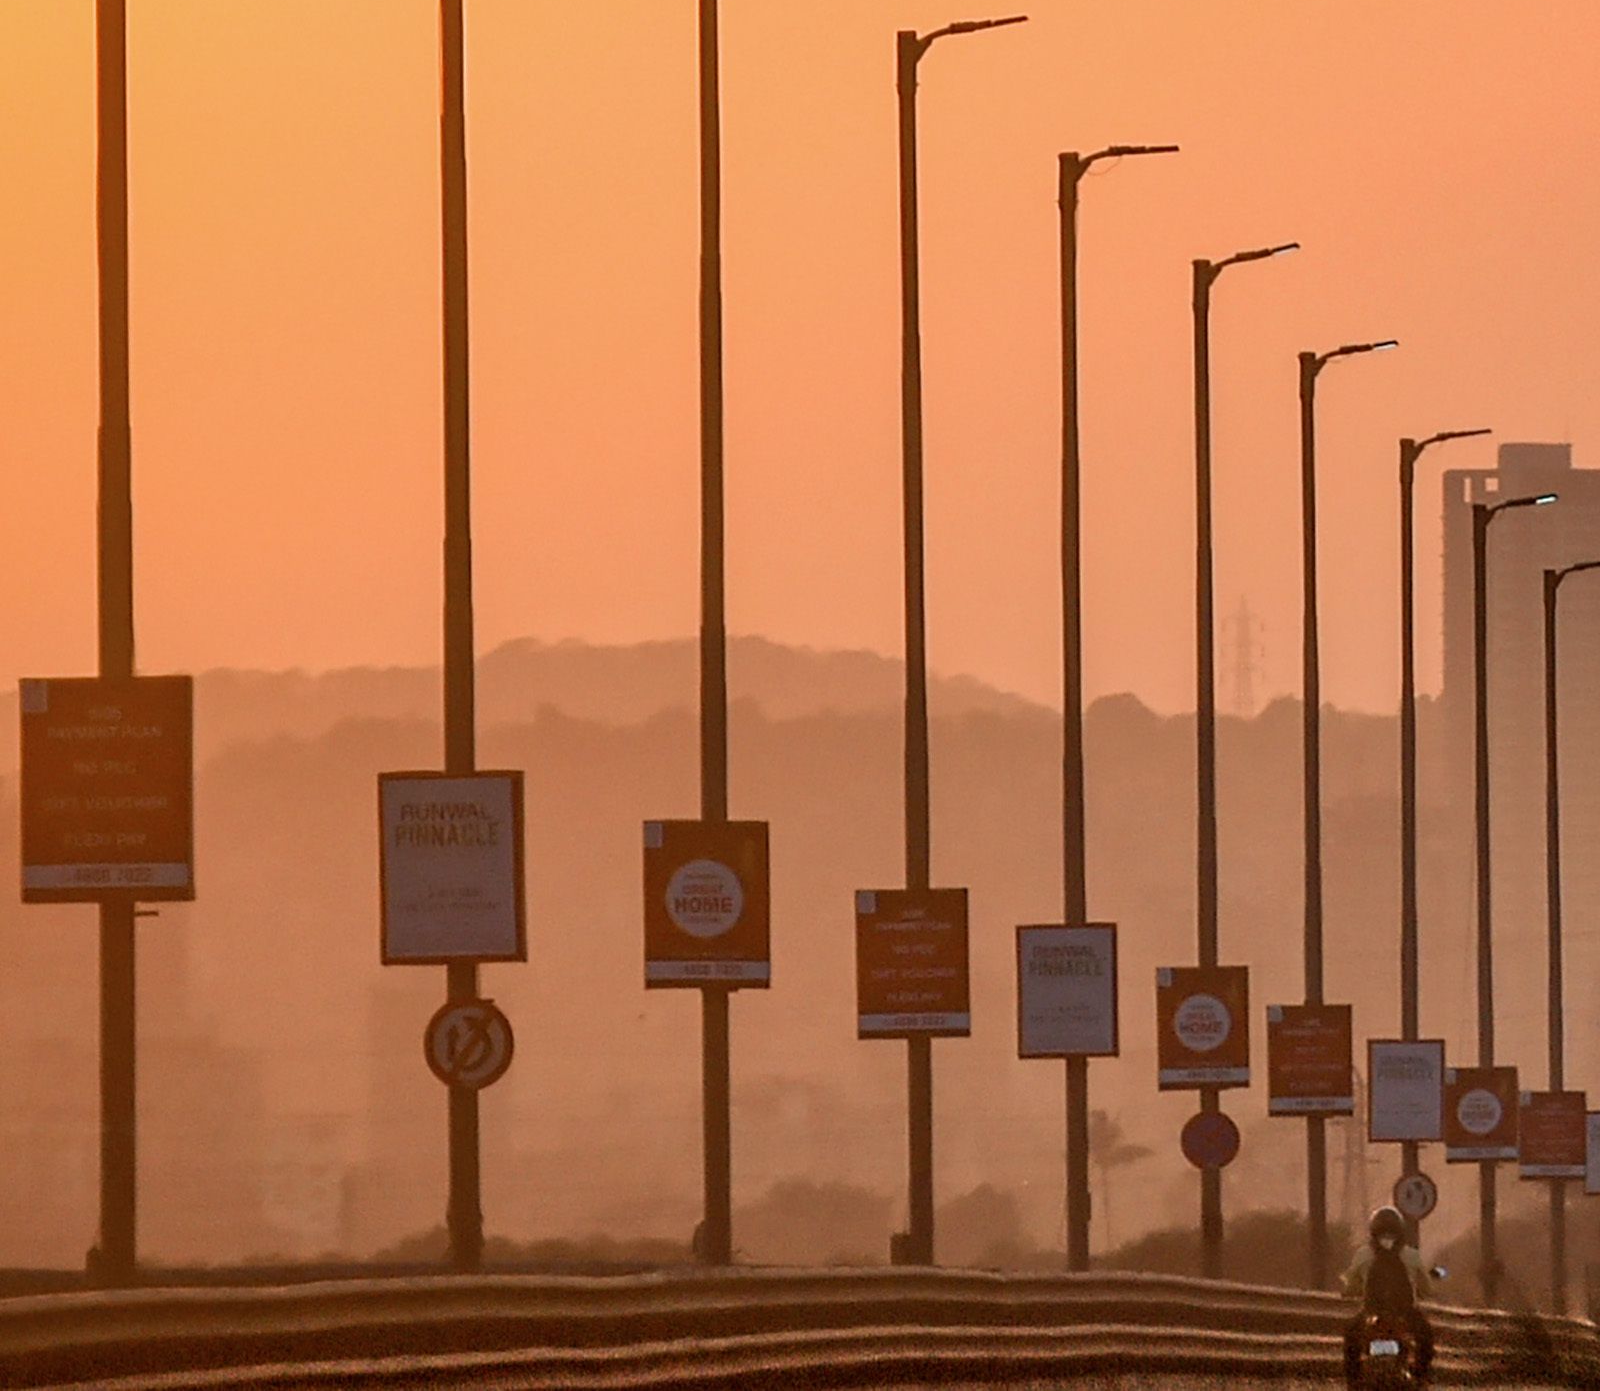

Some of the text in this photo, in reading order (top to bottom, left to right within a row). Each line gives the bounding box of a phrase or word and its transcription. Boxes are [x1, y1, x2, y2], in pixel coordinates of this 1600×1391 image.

[400, 802, 491, 822] RUNWAL
[394, 820, 500, 848] PINNACLE
[674, 896, 733, 914] HOME
